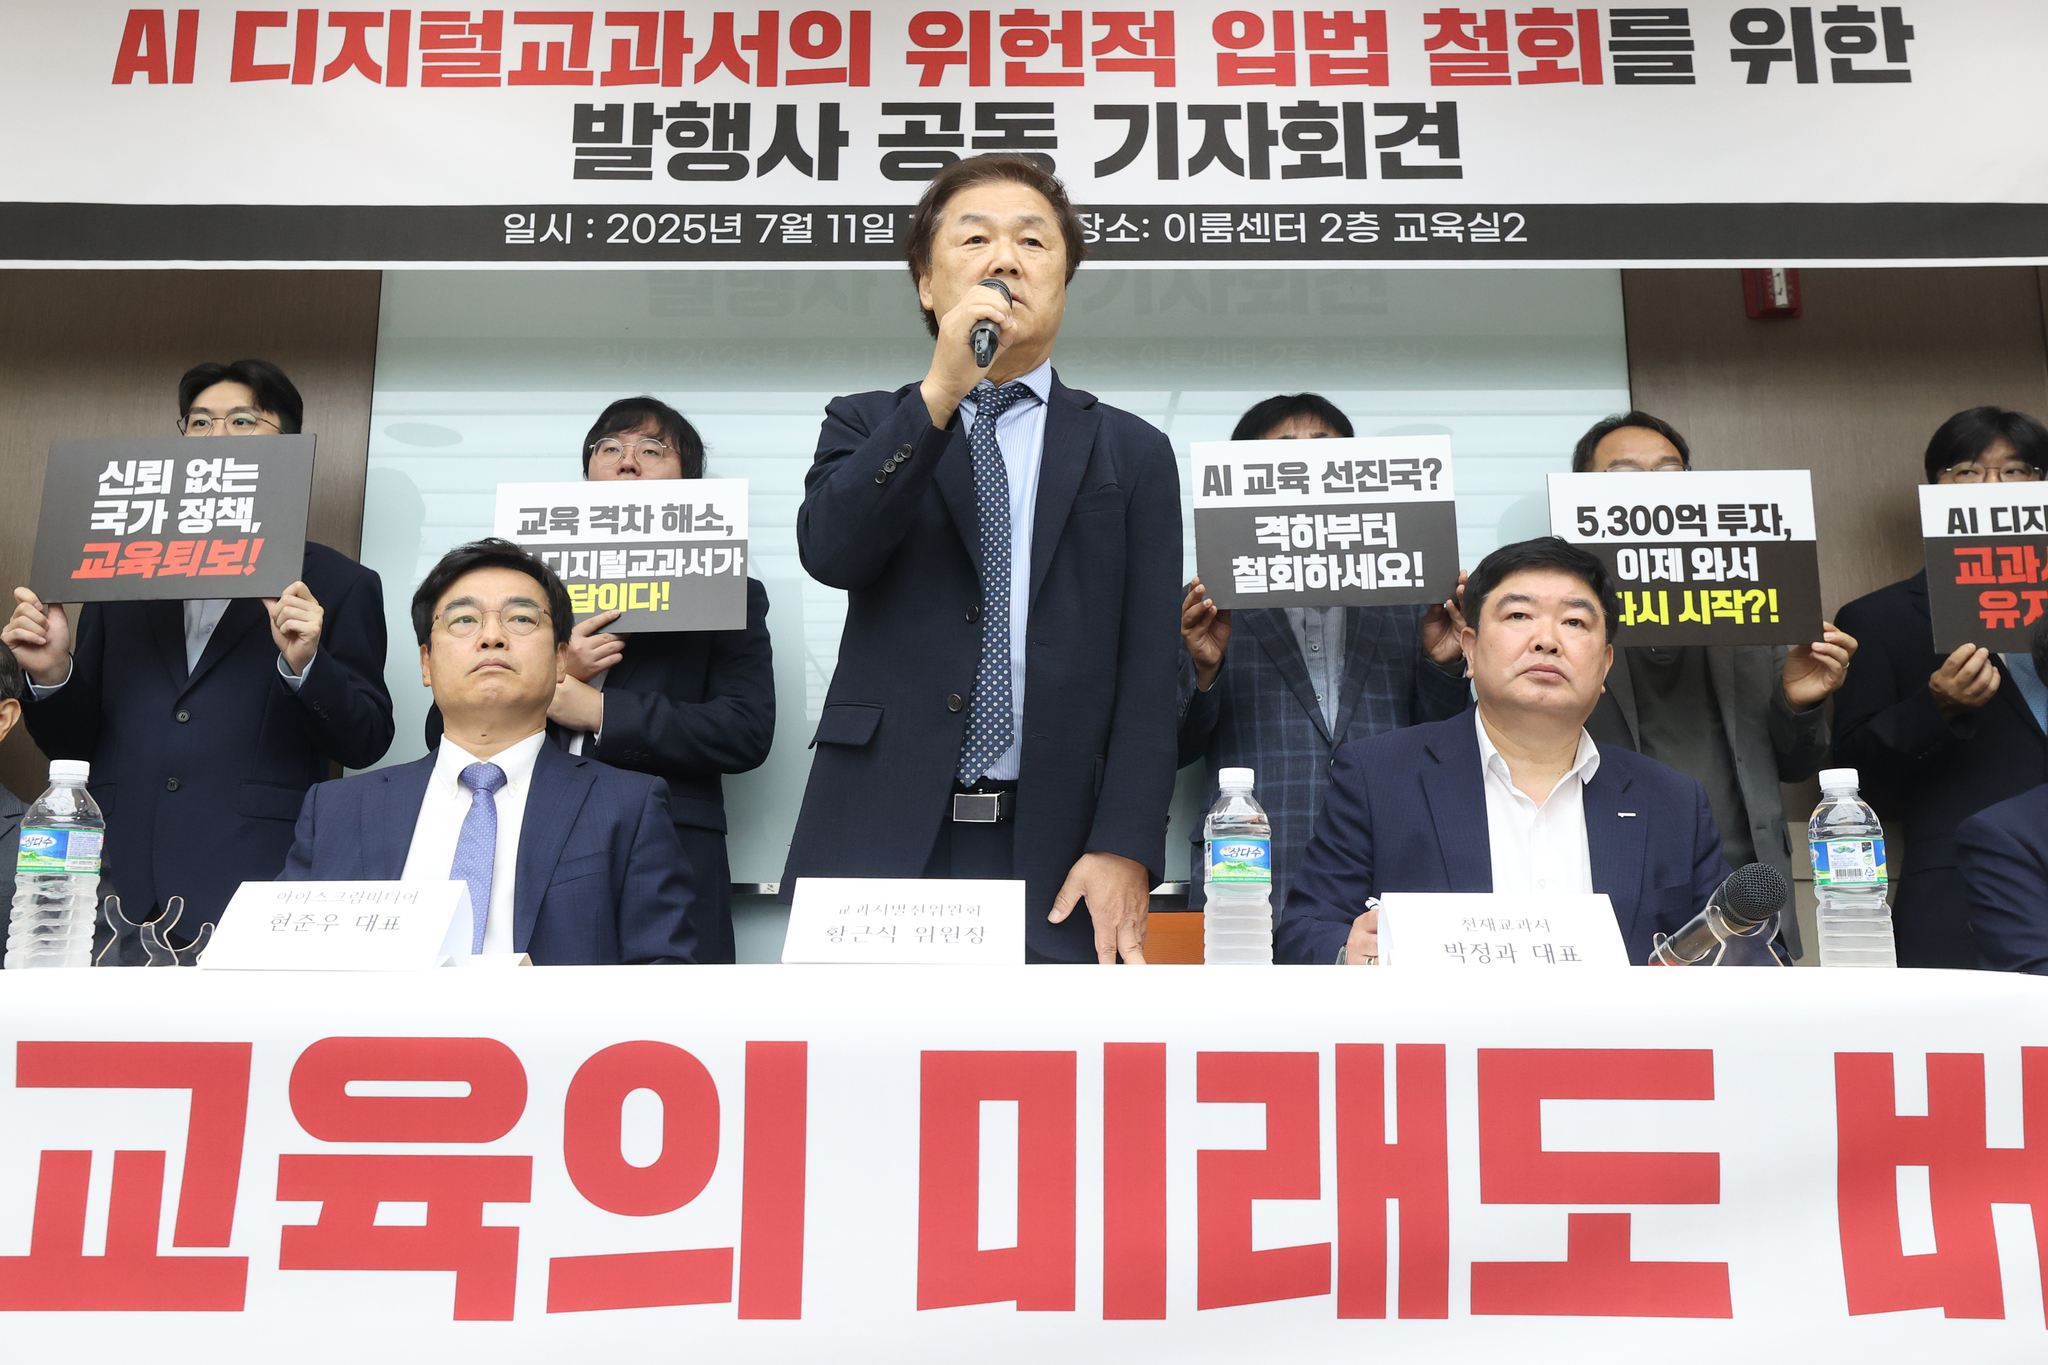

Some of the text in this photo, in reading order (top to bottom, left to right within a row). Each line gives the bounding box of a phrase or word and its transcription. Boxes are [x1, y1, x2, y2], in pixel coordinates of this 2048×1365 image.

[113, 5, 1914, 87] AI 디지털교과서의 위헌적 입법 철회를 위한
[573, 101, 1463, 181] 발행사 공동 기자회견
[503, 213, 572, 244] 일시
[607, 213, 741, 243] 2025년
[756, 214, 812, 243] 7월
[827, 214, 894, 243] 11일
[1079, 213, 1150, 244] 장소:
[1165, 213, 1305, 243] 이룸센터
[1320, 212, 1380, 242] 2층
[1394, 212, 1527, 242] 교육실2
[99, 458, 259, 496] 신뢰 없는
[1203, 458, 1442, 496] AI 교육 선진국?
[91, 497, 261, 535] 국가 정책,
[517, 504, 733, 536] 교육 격차 해소,
[1255, 513, 1397, 551] 격하부터
[1577, 503, 1791, 540] 5,300억 투자,
[1948, 508, 1978, 534] AI
[71, 539, 265, 579] 교육퇴보!
[1233, 551, 1424, 593] 철회하세요!
[1617, 547, 1758, 582] 이제 와서
[1954, 546, 2048, 584] 교과
[1679, 589, 1779, 624] 시작?!
[1229, 846, 1262, 858] 삼다수
[277, 891, 418, 904] 아이스크림미디어
[271, 913, 400, 932] 현준우 대표
[825, 925, 987, 944] 황근식 위원장
[1462, 918, 1550, 932] 천재교과서
[1444, 942, 1582, 964] 박정과 대표
[0, 1037, 807, 1321] 교육의
[917, 1042, 1733, 1320] 미래도
